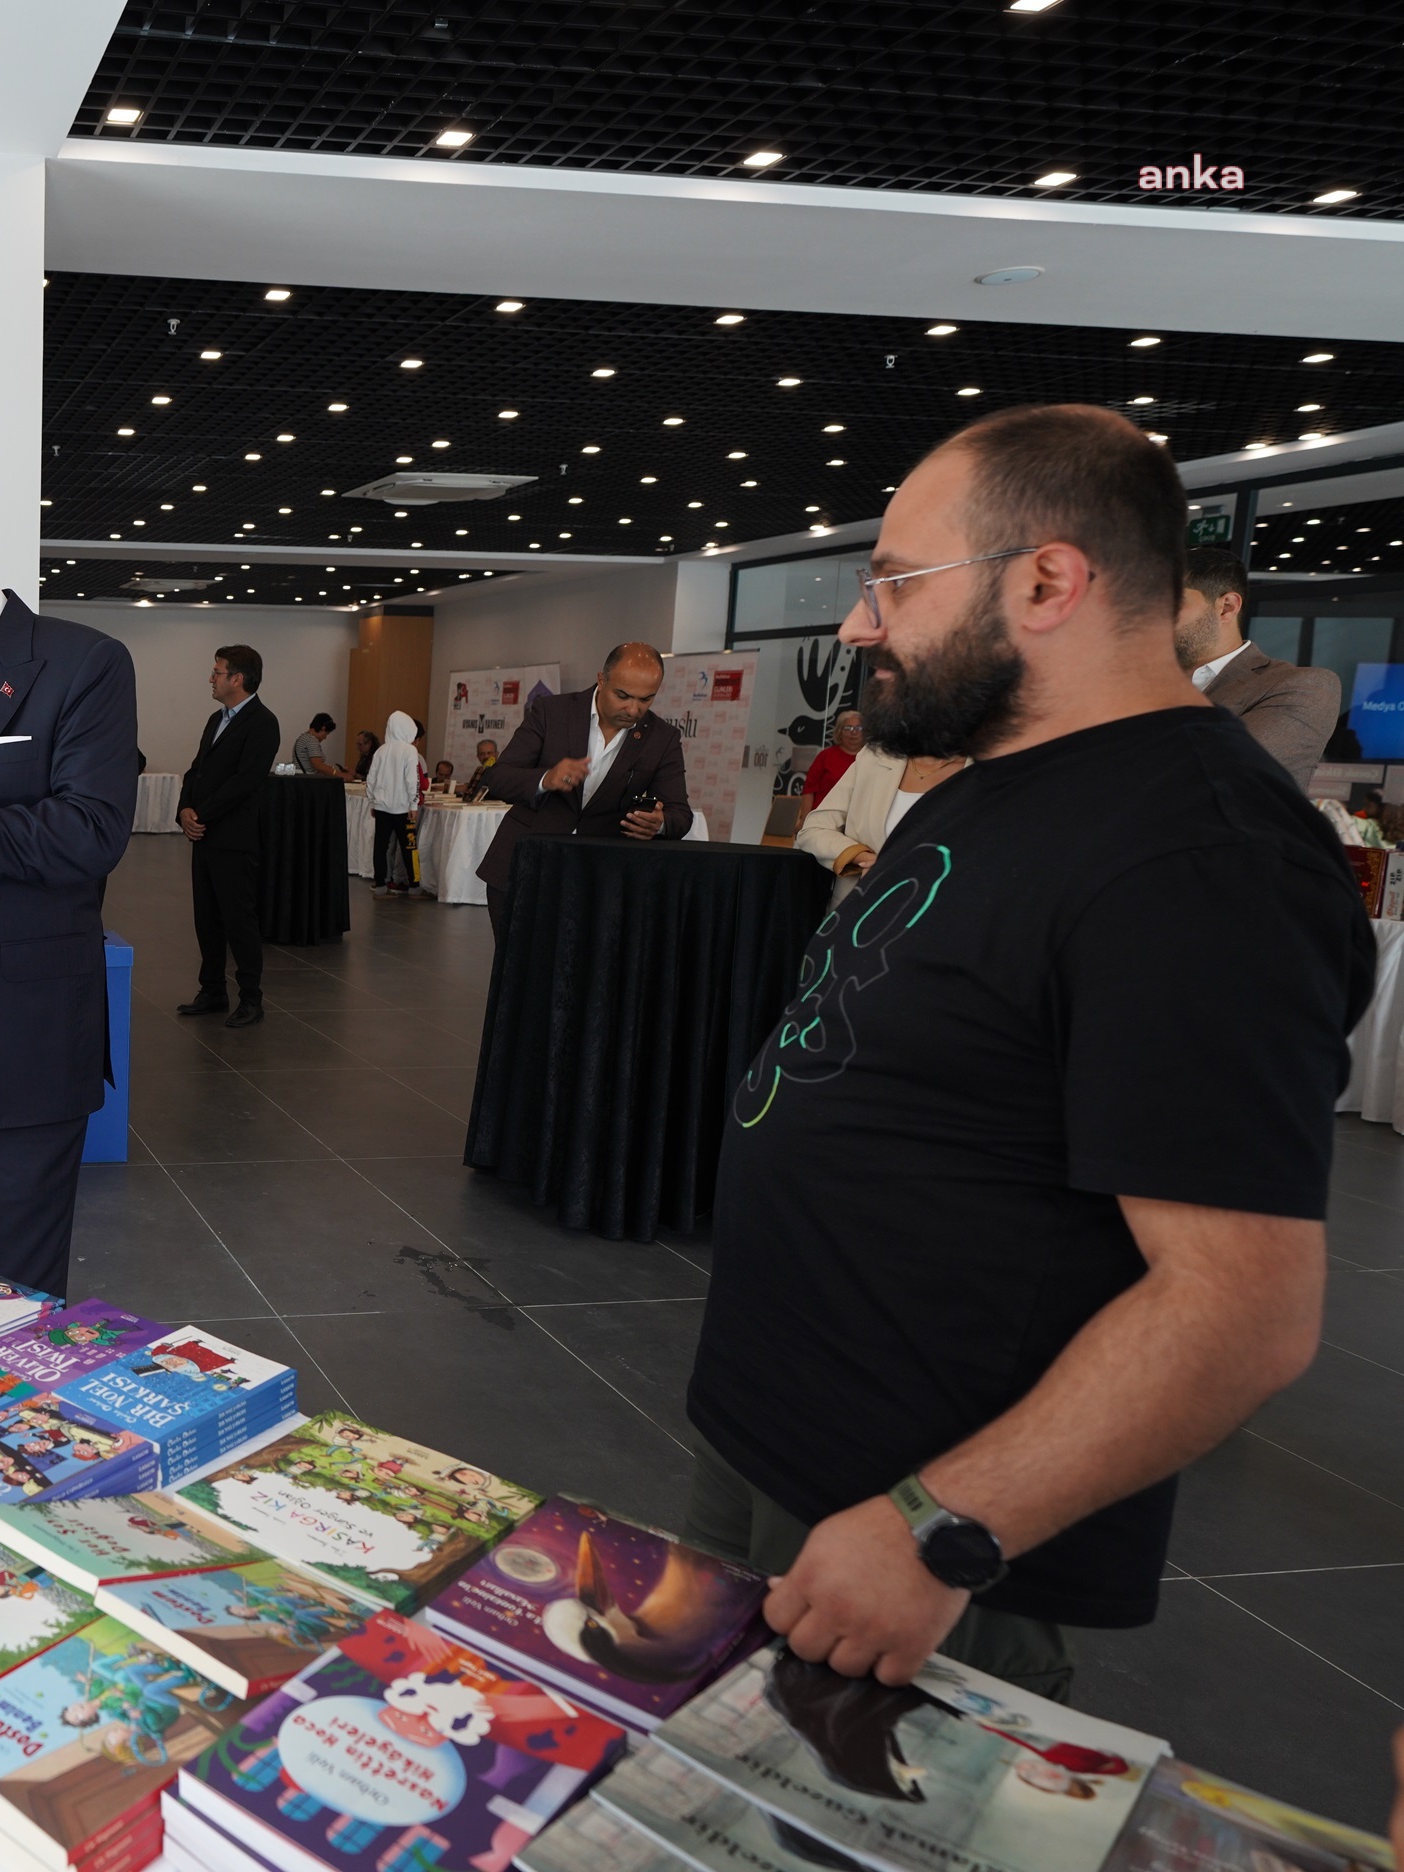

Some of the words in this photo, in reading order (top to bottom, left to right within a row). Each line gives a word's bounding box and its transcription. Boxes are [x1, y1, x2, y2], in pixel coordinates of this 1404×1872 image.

[1362, 701, 1392, 713] Medya
[78, 1379, 137, 1414] NOEL
[98, 1371, 195, 1418] ŞARKISI
[130, 1405, 176, 1429] BİR
[251, 1490, 289, 1513] KIZ
[276, 1488, 311, 1509] Oğlan
[288, 1512, 377, 1555] KASIRGA
[357, 1527, 375, 1539] ve
[461, 1595, 486, 1614] Veli
[292, 1713, 340, 1749] Hoca
[304, 1750, 340, 1776] Veli
[328, 1716, 438, 1784] Hikâyeleri
[339, 1770, 391, 1809] Orhan
[344, 1745, 450, 1814] Nasrettin
